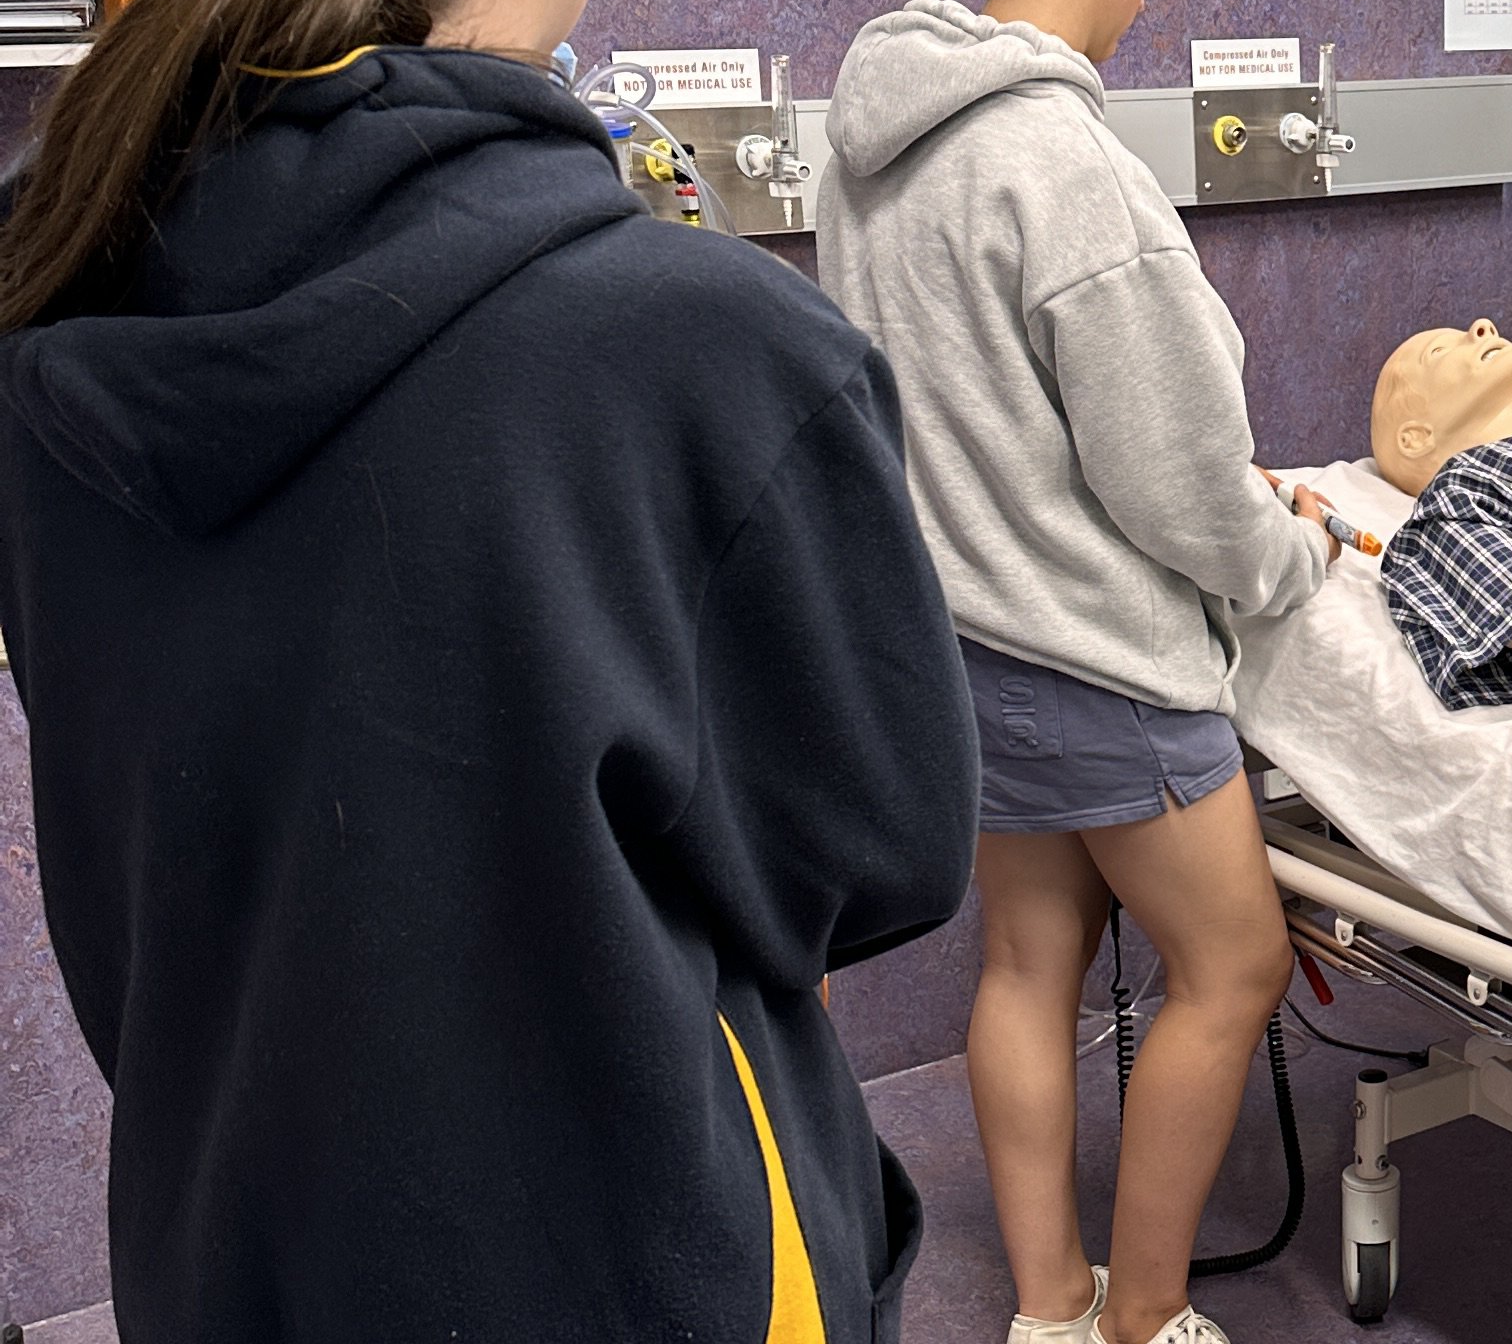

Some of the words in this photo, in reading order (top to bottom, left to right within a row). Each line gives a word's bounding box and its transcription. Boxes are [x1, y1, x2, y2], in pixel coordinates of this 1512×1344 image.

[1203, 50, 1254, 61] Compressed
[1256, 49, 1268, 58] Air
[1271, 49, 1289, 60] Only
[701, 62, 717, 72] Air
[721, 61, 745, 74] Only
[1199, 65, 1216, 75] NOT
[1219, 64, 1236, 75] FOR
[1239, 63, 1275, 74] MEDICAL
[1278, 63, 1294, 73] USE
[658, 80, 673, 90] OR
[677, 78, 728, 90] MEDICAL
[731, 77, 753, 89] USE
